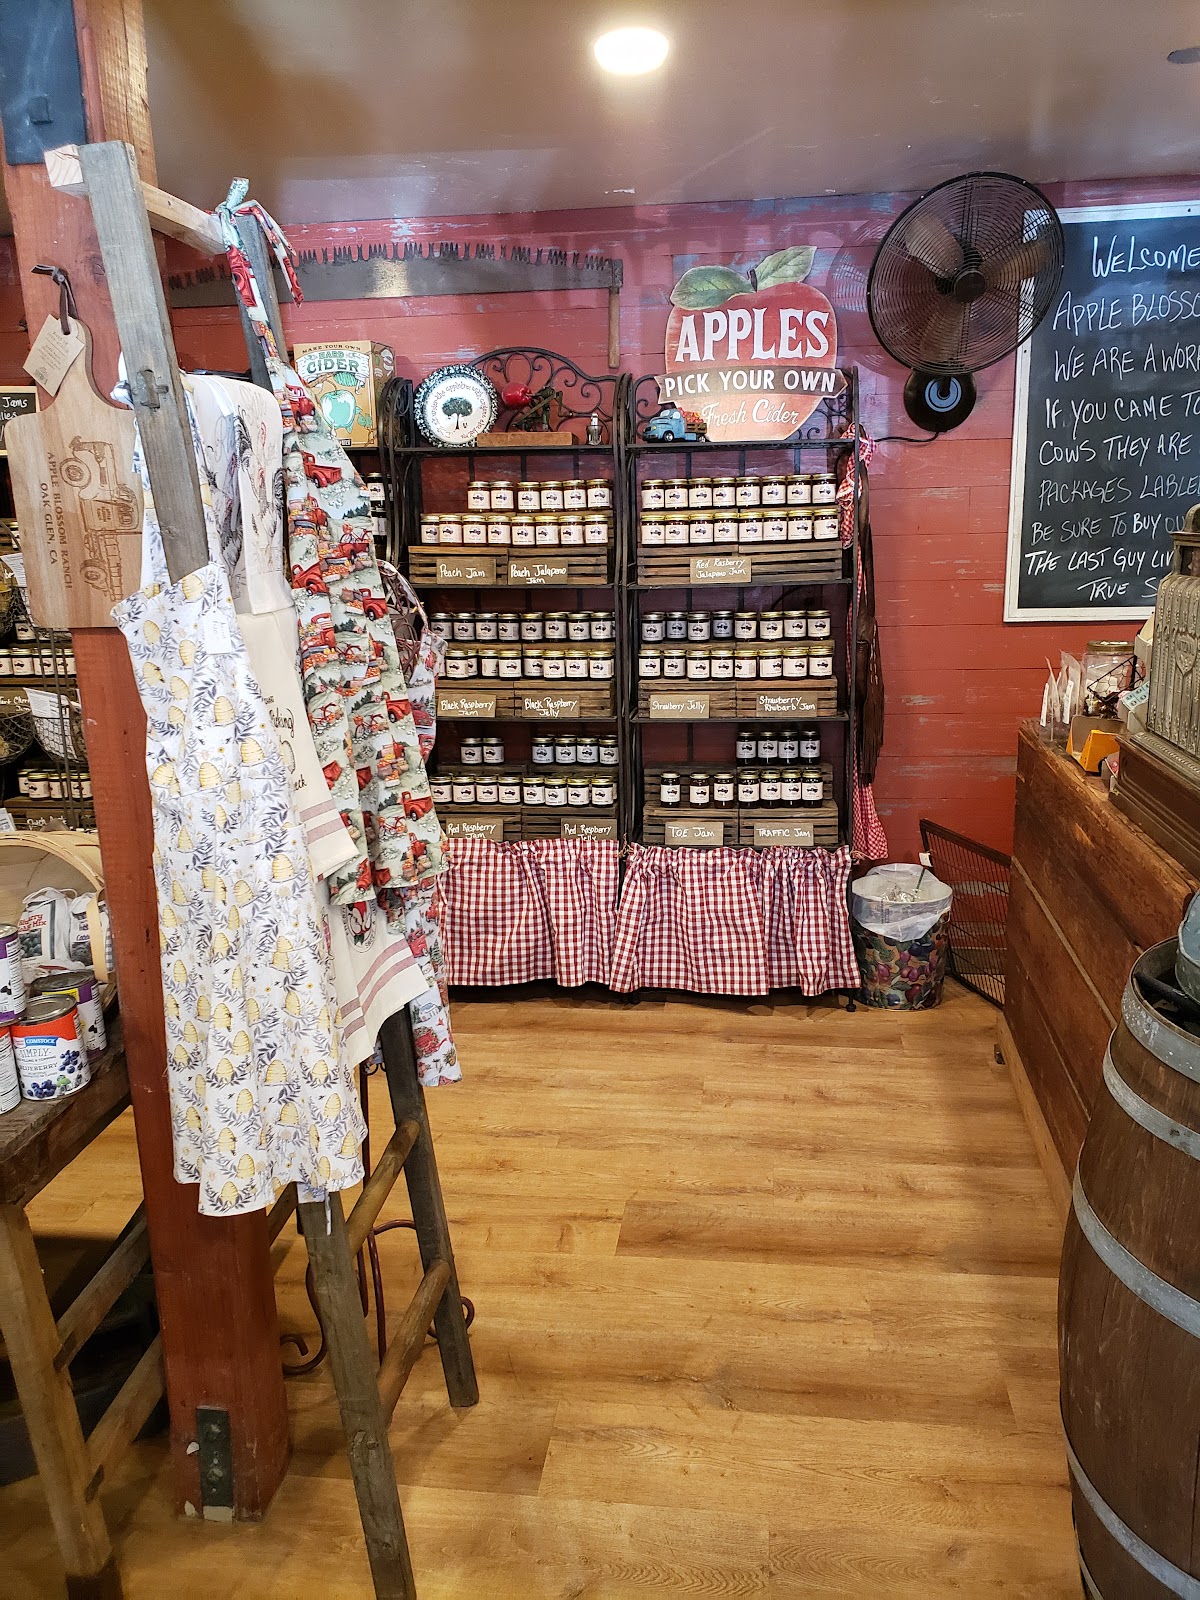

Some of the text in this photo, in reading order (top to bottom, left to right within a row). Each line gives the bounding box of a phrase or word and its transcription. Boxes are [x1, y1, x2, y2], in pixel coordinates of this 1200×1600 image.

[1092, 235, 1200, 277] WELCOME
[1053, 290, 1122, 336] APPLE
[674, 308, 829, 362] APPLES
[306, 358, 360, 374] CIDER
[1055, 345, 1085, 382] WE
[1092, 346, 1134, 380] ARE
[1144, 343, 1157, 372] A
[664, 369, 836, 397] PICK YOUR OWN
[2, 396, 28, 408] Jams
[702, 398, 799, 427] Fresh Cider
[1045, 398, 1062, 429] IF
[1071, 398, 1107, 440] YOU
[1114, 394, 1174, 421] CAME
[1040, 431, 1193, 467] COWS THEY ARE
[1039, 477, 1132, 511] PACKAGES
[40, 482, 58, 565] OAK GLEN, CA
[46, 451, 73, 589] APPLE BLOSSOM RANCH
[1031, 522, 1054, 546] BE
[1060, 517, 1101, 542] SURE
[1110, 512, 1127, 537] TO
[1132, 513, 1161, 540] BUY
[696, 559, 710, 569] Red
[1024, 550, 1061, 576] THE
[1067, 547, 1111, 571] LAST
[1113, 547, 1146, 575] GUY
[439, 564, 485, 579] Peach Jam
[510, 564, 567, 578] Peach Jalapeno
[695, 566, 747, 580] Jalapeno Jam
[1077, 576, 1130, 601] TRUE
[440, 698, 495, 711] Black Raspberry
[524, 696, 578, 711] Black Raspberry
[687, 700, 706, 714] Jelly
[759, 695, 803, 705] Strawberry
[764, 703, 816, 711] Rhubarb Jam
[458, 709, 479, 717] Jam
[539, 709, 560, 718] Jelly
[447, 822, 497, 835] Red Raspberry
[564, 823, 613, 836] Red Raspberry
[692, 826, 715, 837] Jam
[756, 828, 790, 837] TRAFFIC
